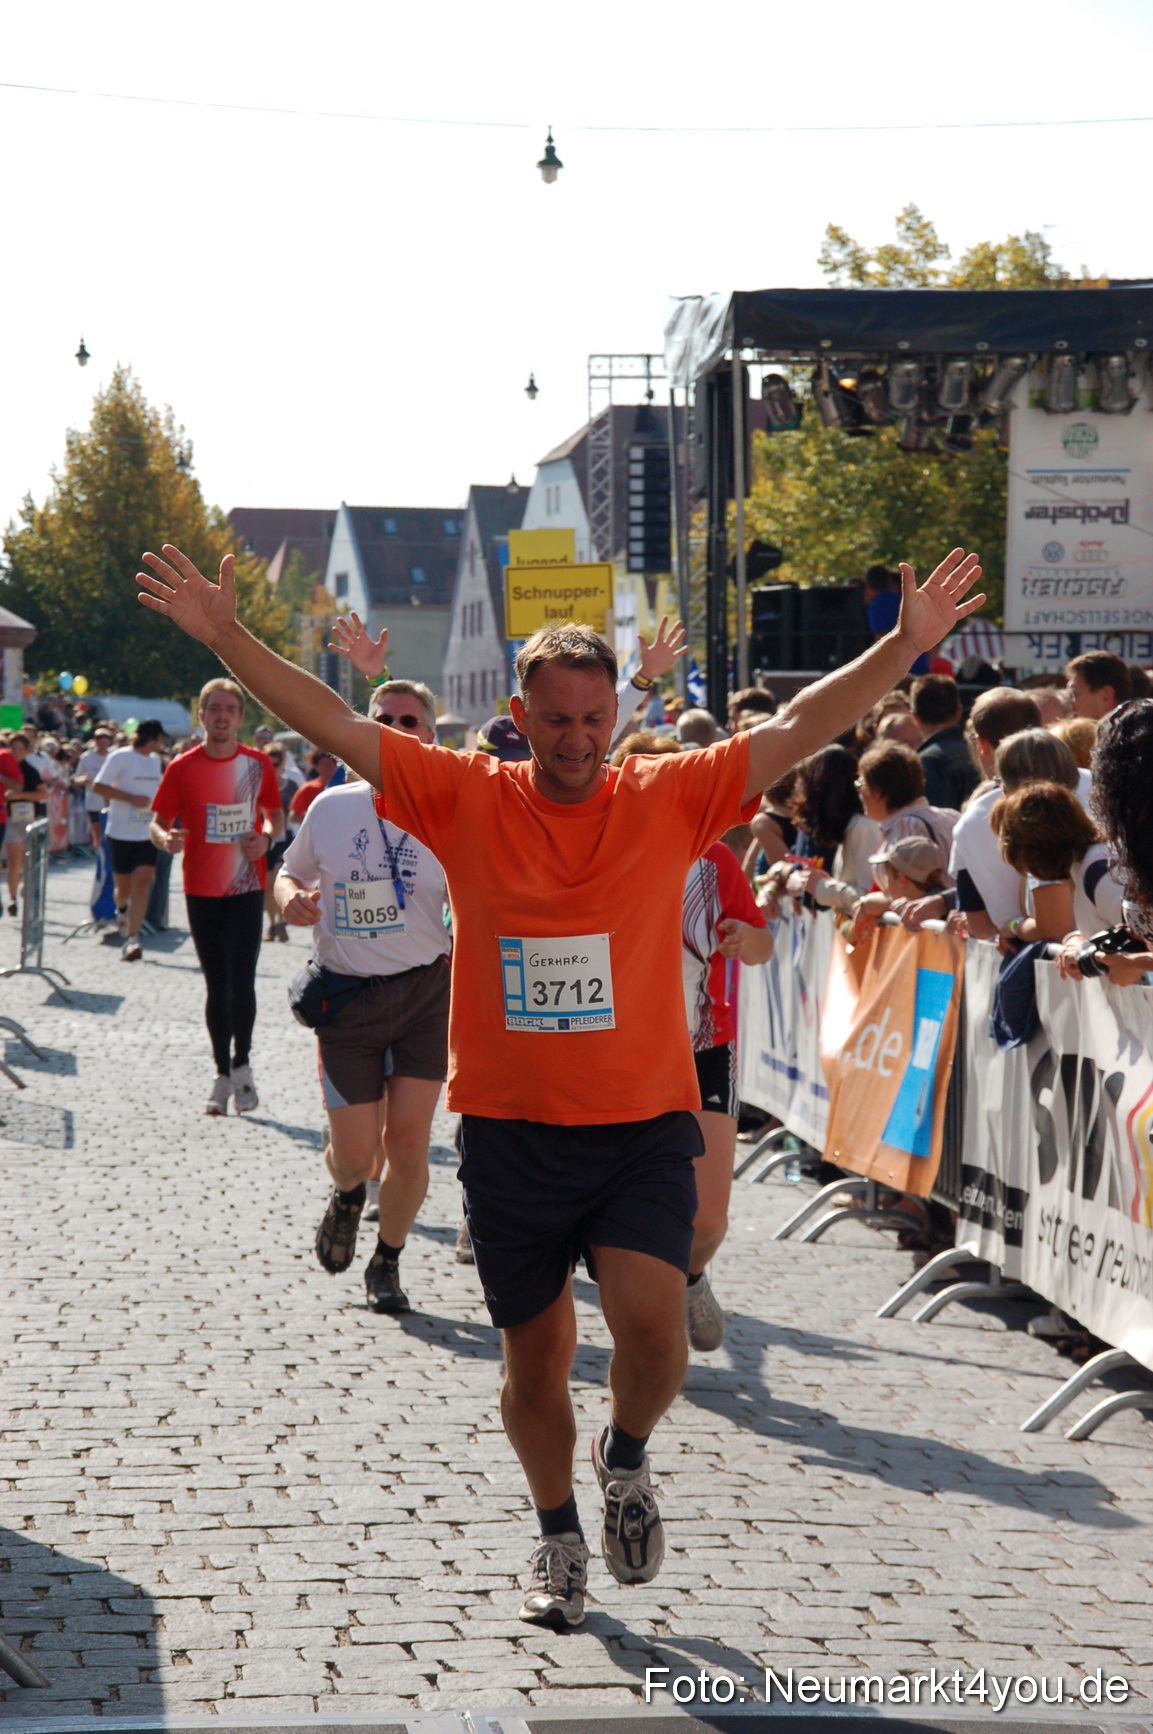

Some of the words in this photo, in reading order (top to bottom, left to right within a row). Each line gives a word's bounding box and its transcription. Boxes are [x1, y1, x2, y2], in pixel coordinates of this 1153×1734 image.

[512, 586, 605, 602] Schnupper-
[544, 604, 574, 619] lauf
[219, 820, 247, 833] 3177
[348, 888, 366, 900] Rolf
[352, 905, 398, 925] 3059
[532, 978, 604, 1006] 3712
[570, 1015, 613, 1025] PFLEIDERER
